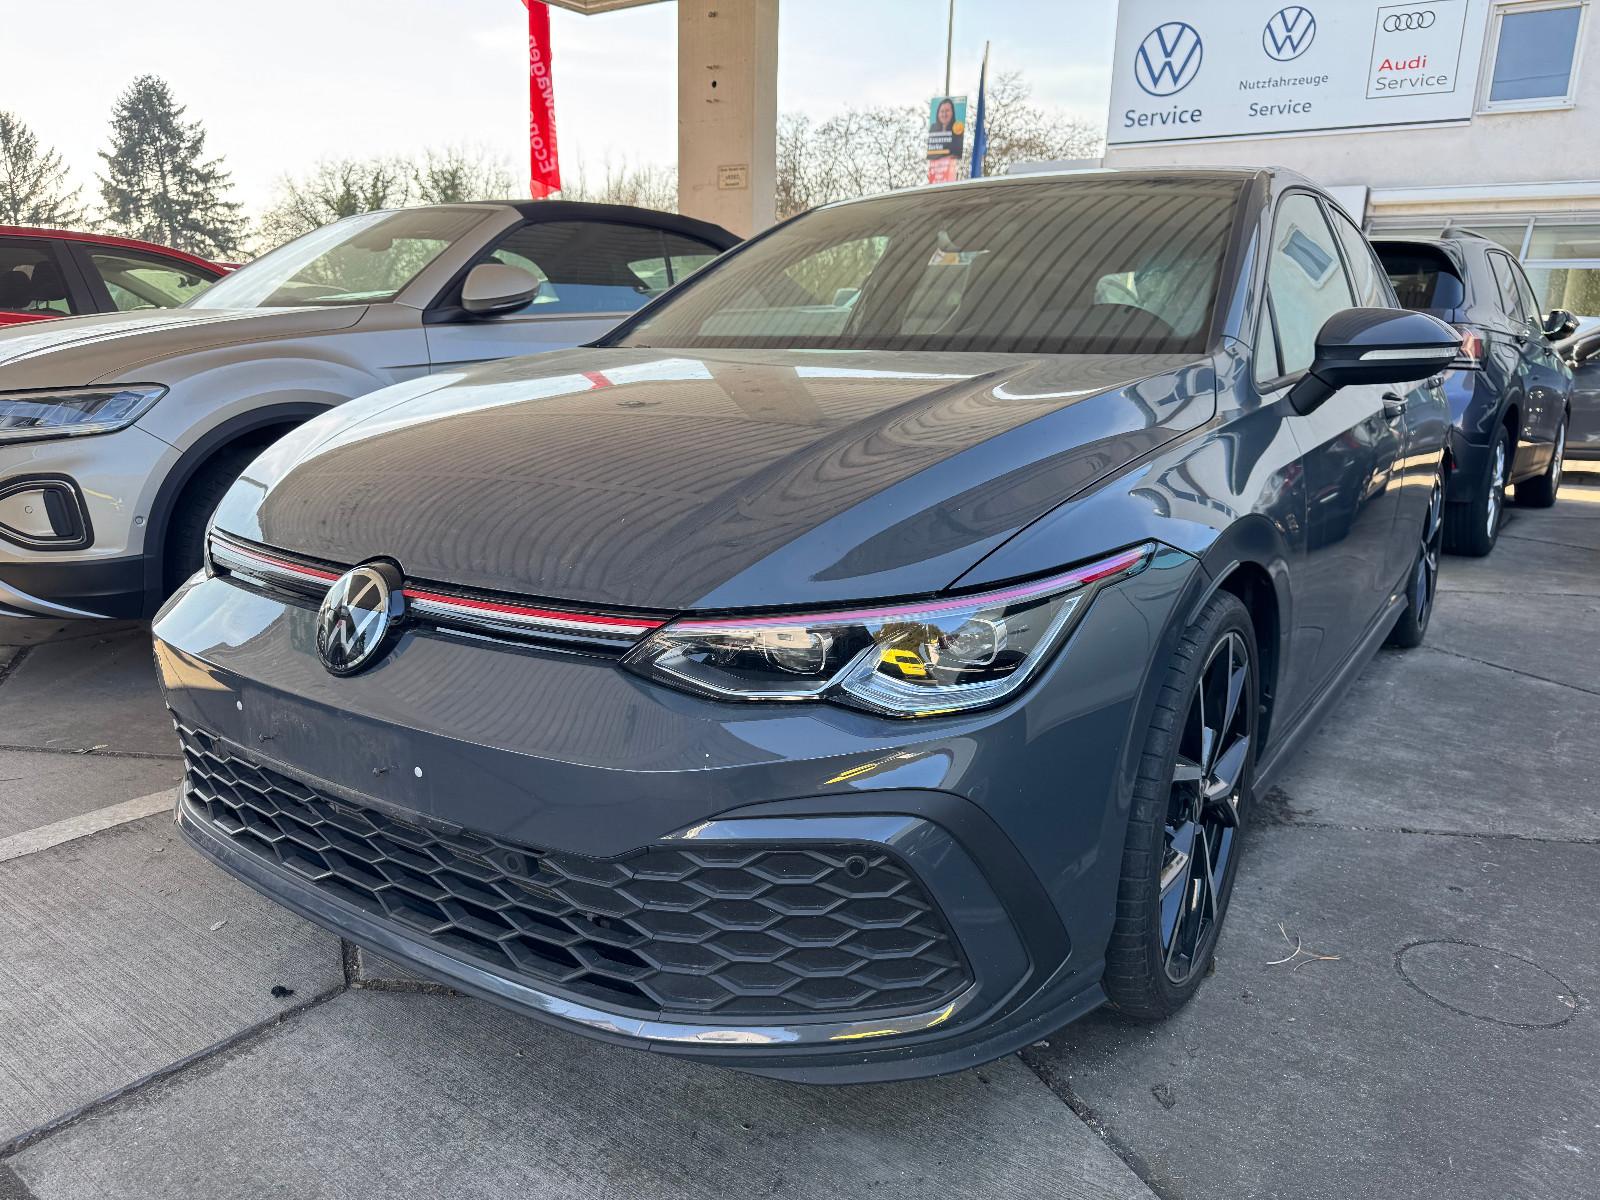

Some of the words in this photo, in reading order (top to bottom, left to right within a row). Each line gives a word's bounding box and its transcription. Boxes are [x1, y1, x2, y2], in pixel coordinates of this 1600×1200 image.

[1378, 55, 1427, 72] Audi
[1238, 73, 1329, 90] Nutzfahrzeuge
[1375, 73, 1448, 91] Service
[1124, 106, 1202, 128] Service
[1249, 100, 1312, 117] Service
